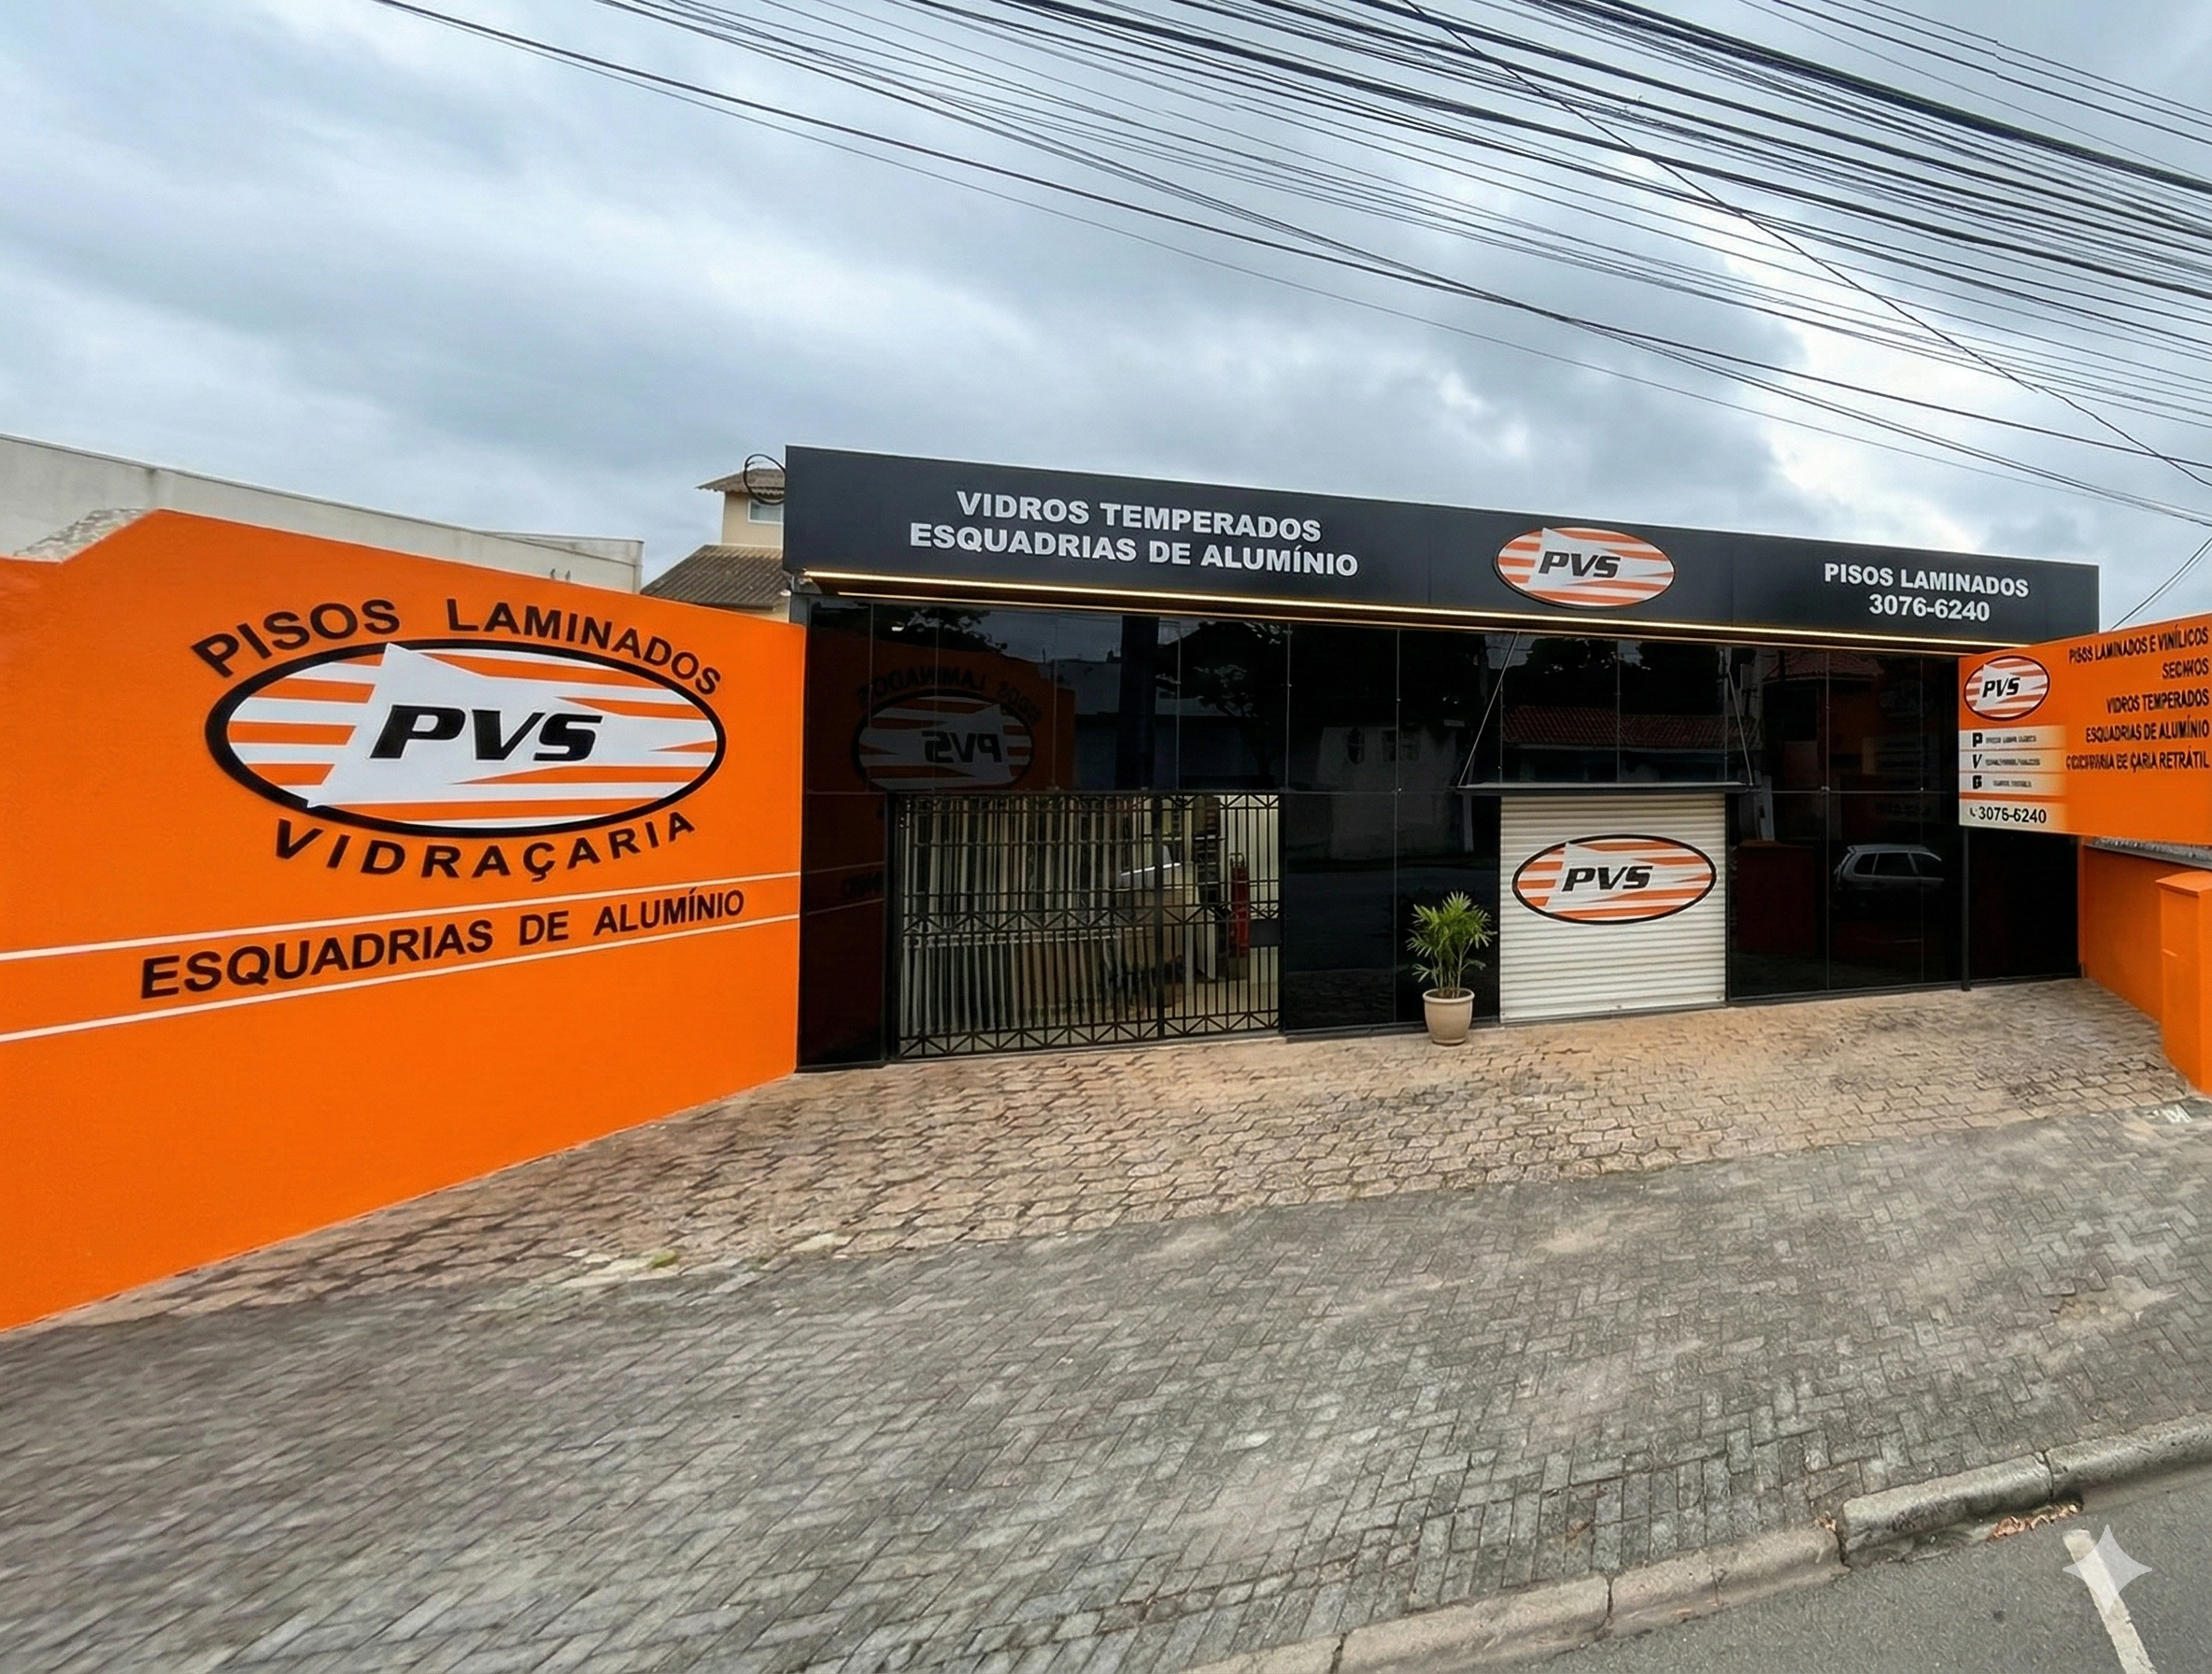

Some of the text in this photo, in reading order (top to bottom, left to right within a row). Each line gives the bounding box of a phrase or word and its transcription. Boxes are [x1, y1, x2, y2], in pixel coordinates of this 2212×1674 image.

[957, 491, 1322, 542] VIDROS TEMPERADOS
[910, 522, 1359, 577] ESQUADRIAS DE ALUMÍNIO
[1538, 550, 1621, 578] PVS
[1824, 563, 2029, 598] PISOS LAMINADOS
[1869, 594, 1991, 622] 3076-6240
[189, 598, 722, 696] PISOS LAMINADOS
[2149, 634, 2156, 653] E
[1982, 676, 2021, 699] PVS
[2142, 688, 2209, 712] TEMPERADOS
[369, 704, 603, 762] PVS
[1972, 732, 1983, 747] P
[2144, 722, 2157, 741] DE
[2159, 714, 2210, 740] ALUMÍNIO
[1972, 754, 1983, 769] V
[2160, 745, 2210, 770] RETRÁTIL
[274, 811, 695, 882] VIDRAÇARIA
[1561, 865, 1653, 892] PVS
[140, 886, 744, 1000] ESQUADRIAS DE ALUMÍNIO
